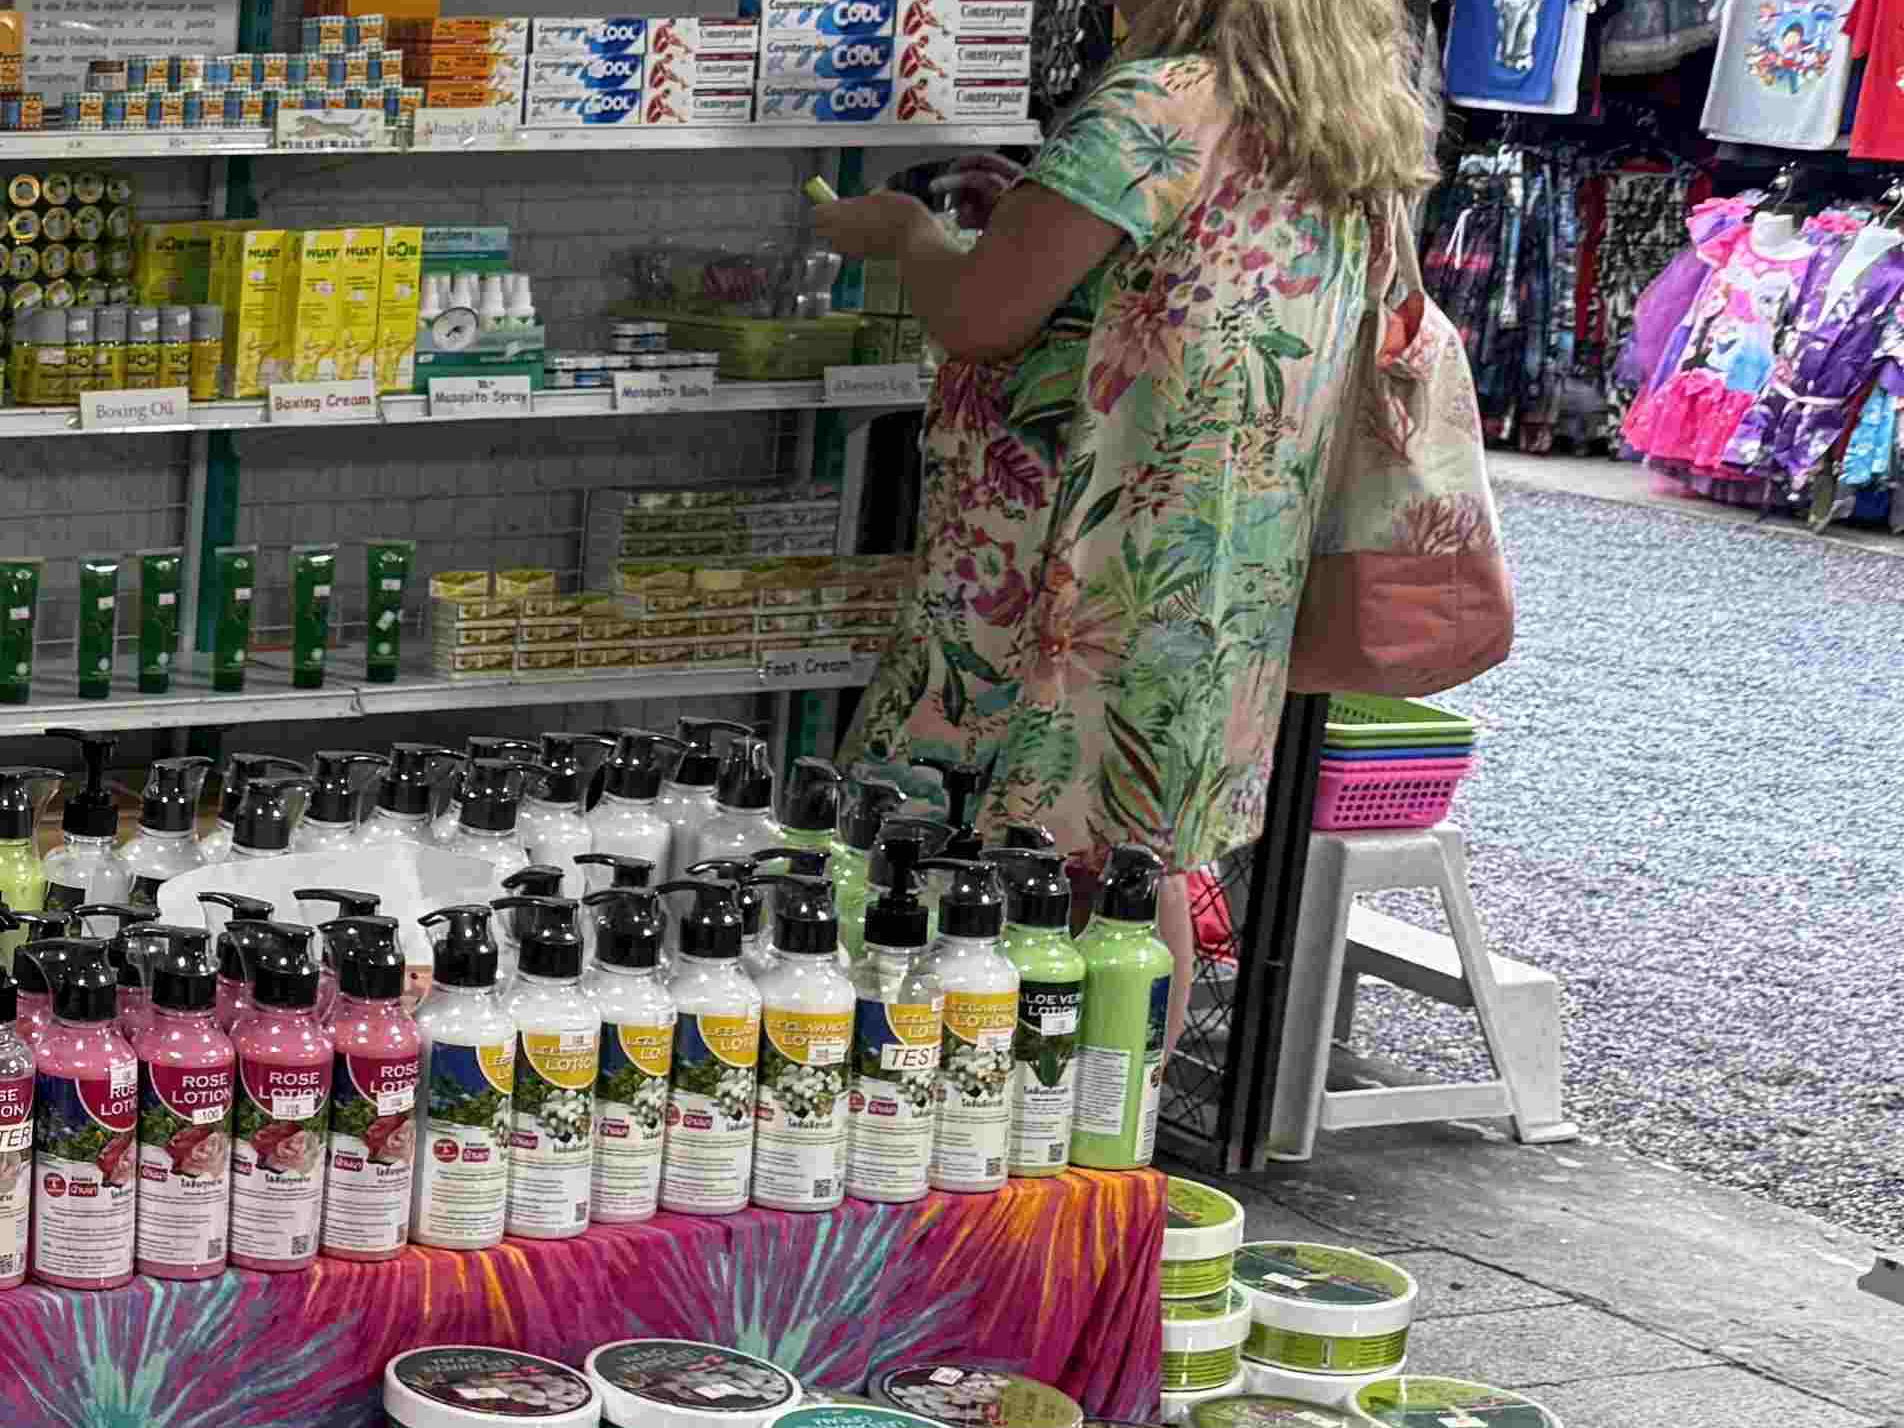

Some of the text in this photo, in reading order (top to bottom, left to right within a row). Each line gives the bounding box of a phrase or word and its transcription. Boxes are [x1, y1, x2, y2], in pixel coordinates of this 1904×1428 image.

[833, 0, 884, 26] COOL
[832, 45, 883, 70] COOL
[829, 88, 881, 112] COOL
[273, 392, 371, 413] Boxing Cream
[434, 391, 528, 408] Mosquito Spray
[94, 400, 176, 422] Boxing Oil
[805, 657, 852, 674] Cream
[181, 1073, 230, 1088] ROSE
[268, 1071, 321, 1086] ROSE
[170, 1086, 233, 1105] LOTION
